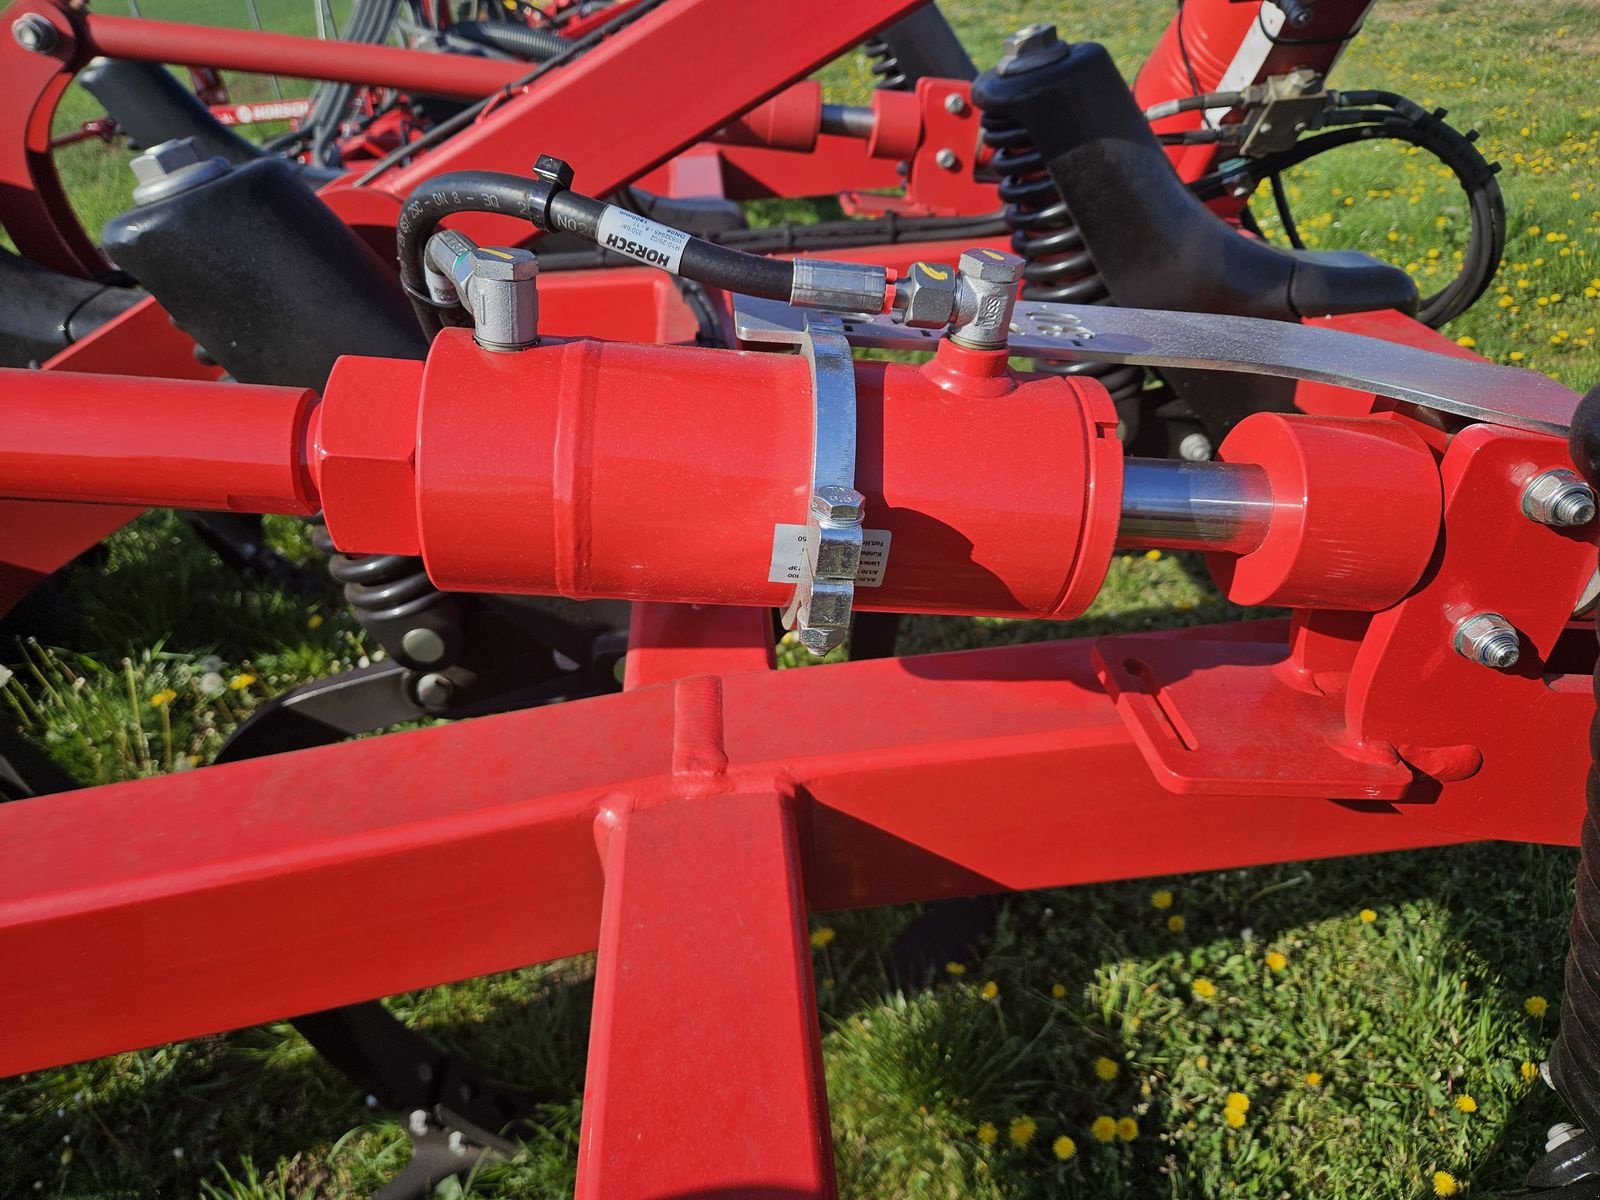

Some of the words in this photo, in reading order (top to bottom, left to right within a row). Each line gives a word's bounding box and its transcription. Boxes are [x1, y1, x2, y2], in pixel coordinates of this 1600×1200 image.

[432, 191, 450, 206] DN
[451, 191, 462, 204] 8
[605, 232, 671, 267] HORSCH
